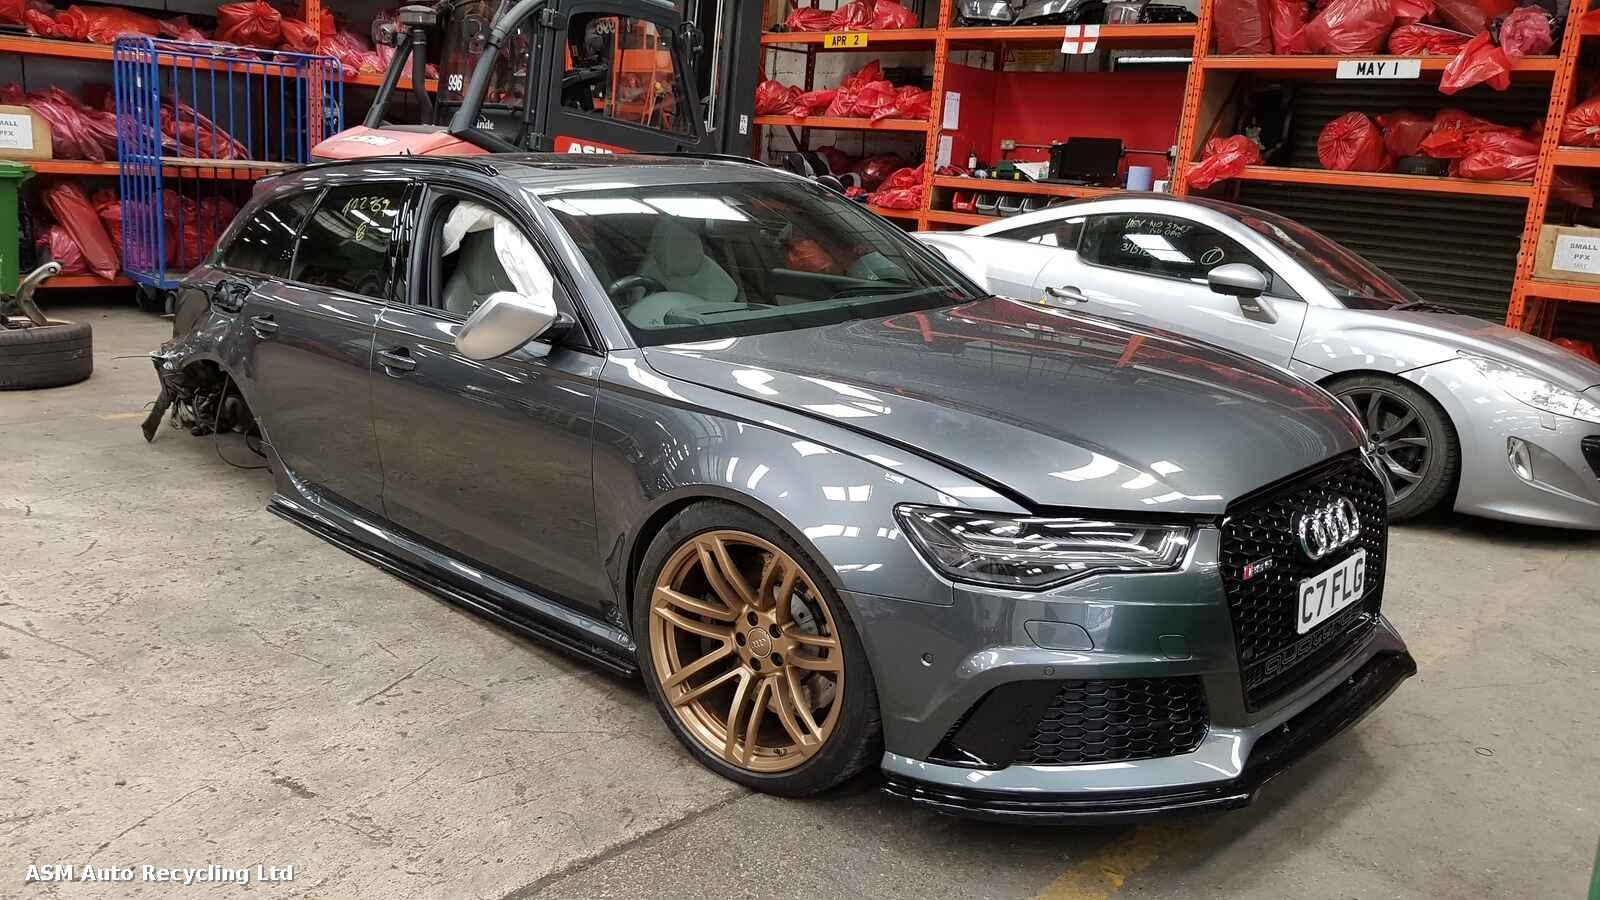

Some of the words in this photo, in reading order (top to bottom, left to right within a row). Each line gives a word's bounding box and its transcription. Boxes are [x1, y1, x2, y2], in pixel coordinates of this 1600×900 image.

[832, 35, 847, 46] APR
[854, 34, 859, 45] 2
[1356, 62, 1386, 76] MAY
[447, 74, 463, 91] 996
[476, 119, 495, 130] inde
[1301, 585, 1328, 624] C7
[1330, 557, 1363, 609] FLG
